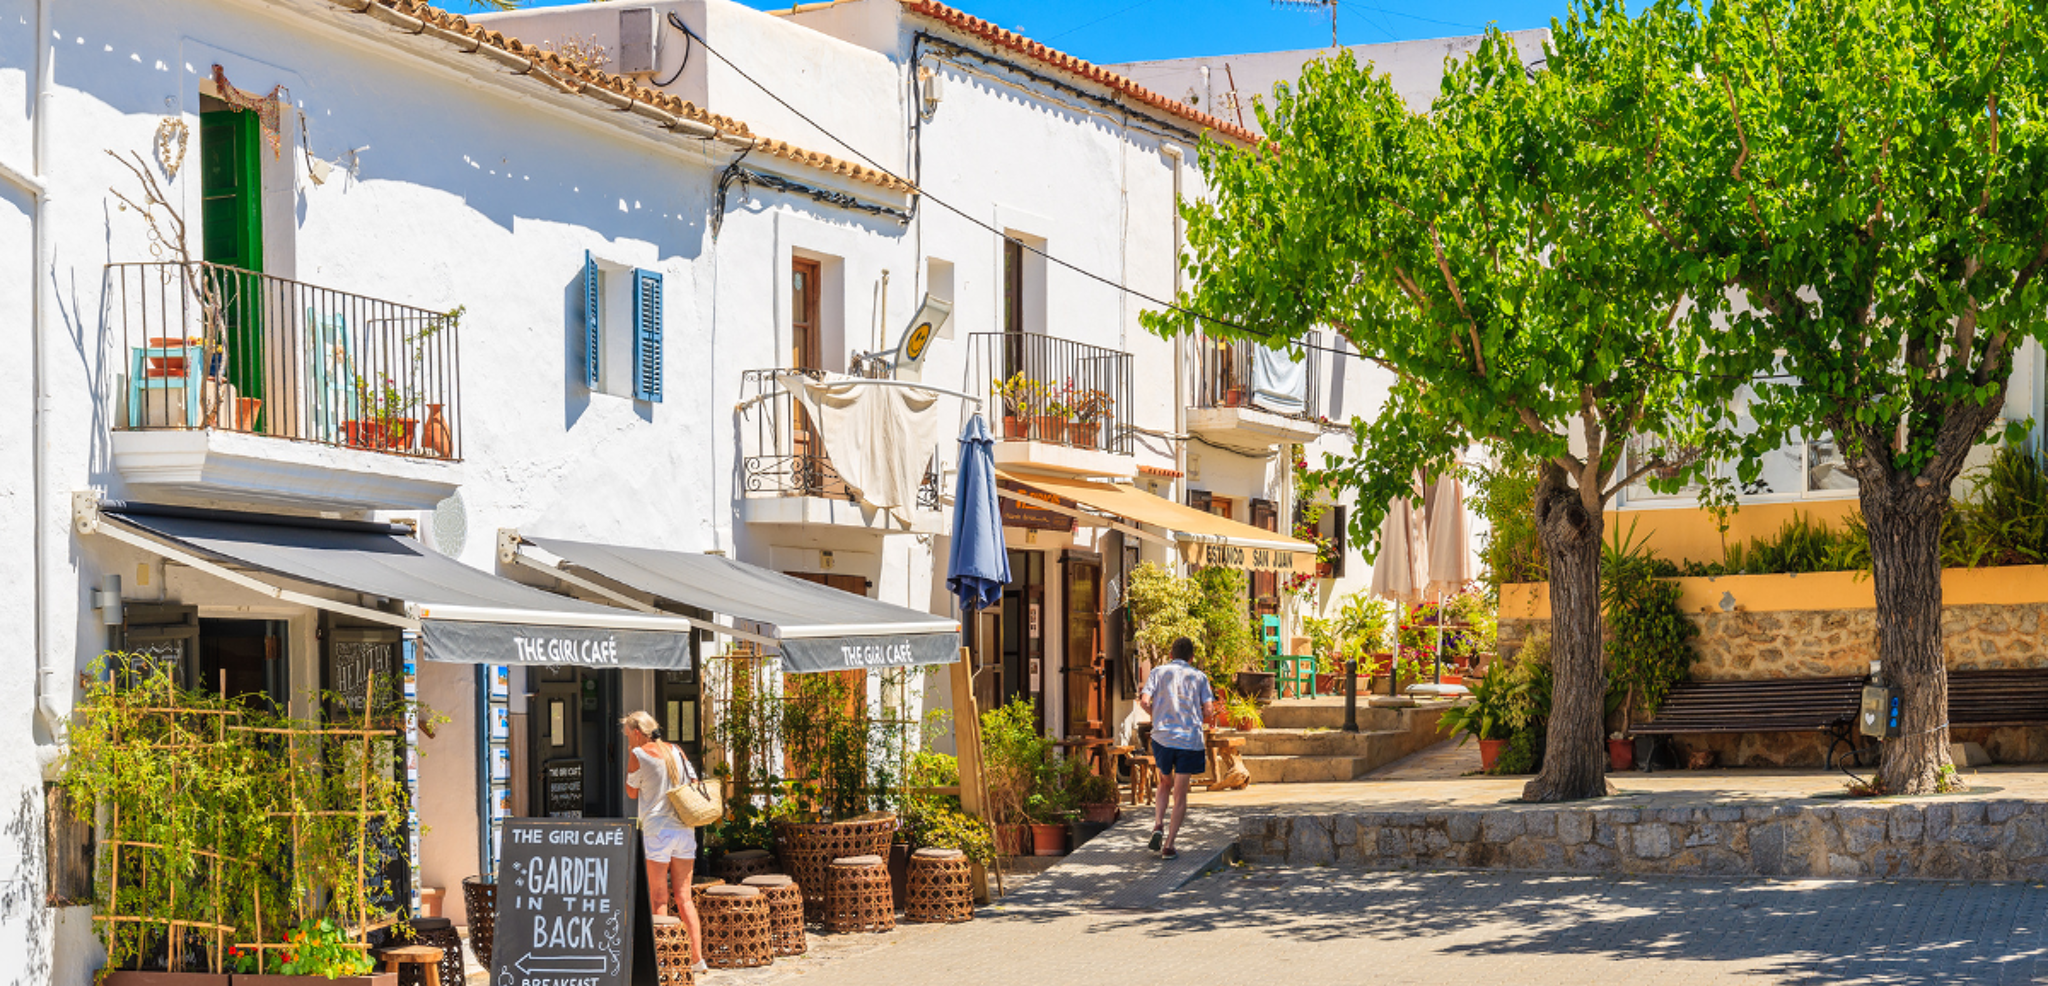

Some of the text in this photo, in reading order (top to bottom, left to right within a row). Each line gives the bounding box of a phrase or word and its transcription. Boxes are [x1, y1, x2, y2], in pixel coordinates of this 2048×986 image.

[1206, 544, 1293, 569] ESTANCO SAN JUAN
[514, 636, 618, 664] THE GIRI CAFÉ
[841, 640, 914, 666] THE GIRI CAFÉ
[512, 827, 624, 845] THE GIRI CAFÉ
[528, 856, 609, 896] GARDEN
[515, 895, 610, 913] IN THE
[533, 915, 595, 949] BACK
